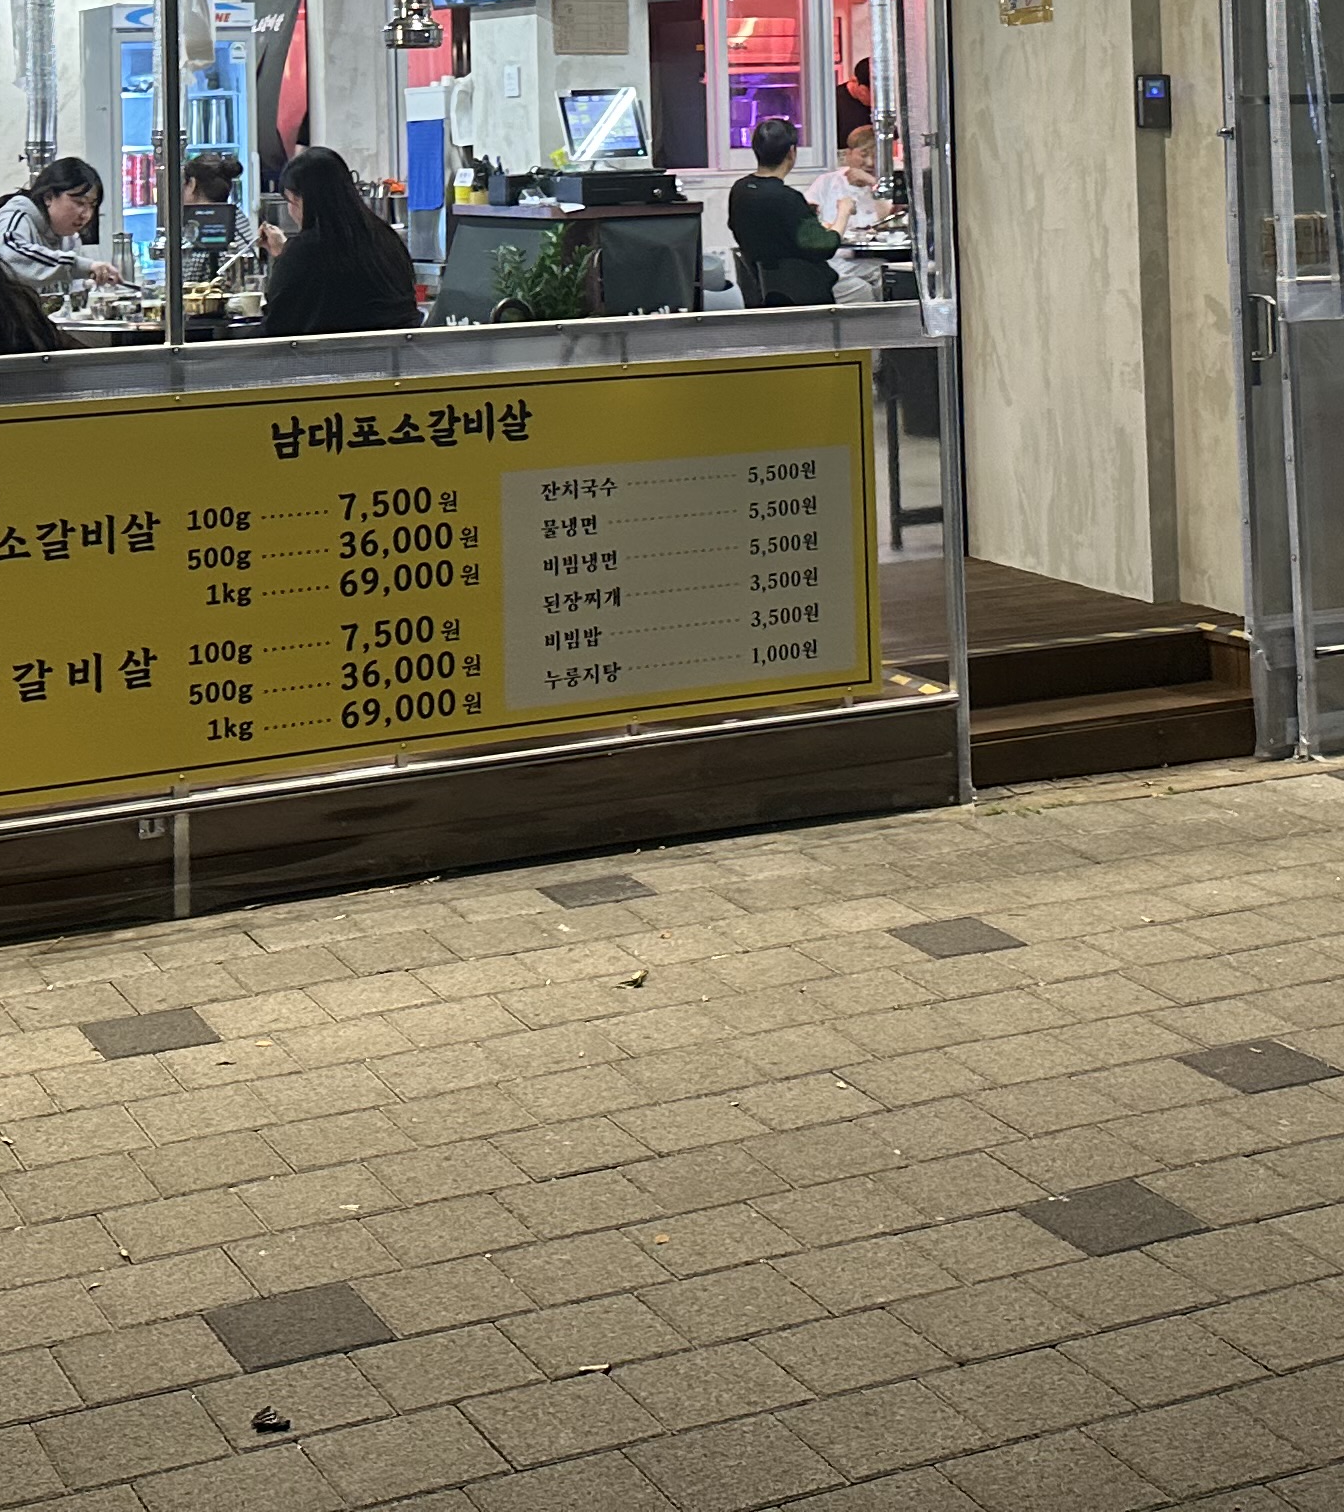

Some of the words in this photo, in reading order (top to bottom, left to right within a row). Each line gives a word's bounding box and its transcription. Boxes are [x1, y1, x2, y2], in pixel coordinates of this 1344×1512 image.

[270, 398, 533, 460] 남대포소갈비살
[541, 477, 618, 502] 잔치국수
[747, 459, 818, 485] 5,500원
[186, 506, 252, 532] 100g
[541, 513, 598, 539] 물냉면
[748, 495, 818, 521] 5,500원
[186, 544, 252, 572] 500g
[542, 549, 619, 577] 비빔냉면
[749, 531, 819, 557] 5,500원
[205, 581, 253, 609] 1kg
[542, 586, 621, 615] 된장찌개
[749, 566, 819, 593] 3,500원
[544, 625, 603, 652] 비빔밥
[750, 602, 820, 629] 3,500원
[188, 640, 253, 667] 100g
[544, 661, 622, 690] 누룽지탕
[752, 639, 819, 666] 1,000원
[188, 679, 253, 707] 500g
[206, 715, 254, 743] 1kg
